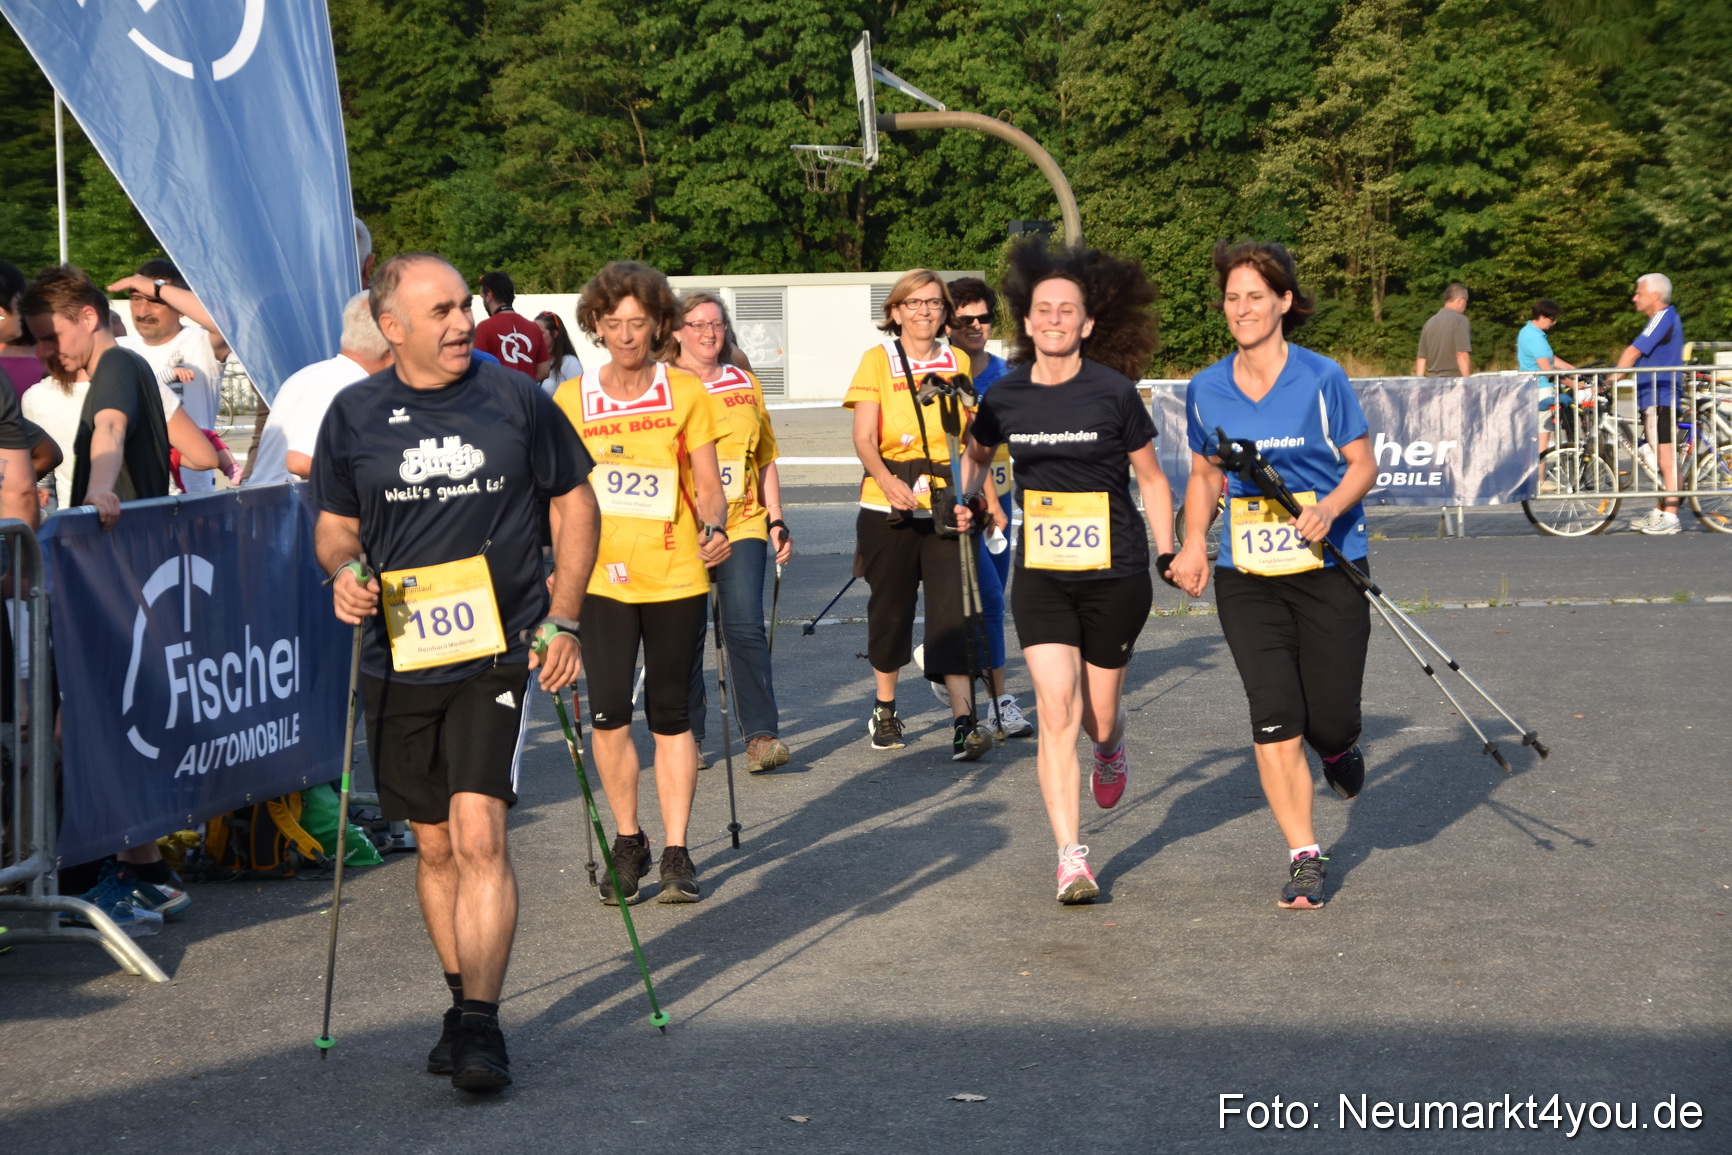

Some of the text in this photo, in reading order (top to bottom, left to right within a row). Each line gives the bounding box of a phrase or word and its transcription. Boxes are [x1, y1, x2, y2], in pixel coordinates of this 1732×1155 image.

[722, 392, 758, 408] BÖGL
[583, 416, 677, 438] MAX BÖGL
[1009, 430, 1098, 445] energiegeladen
[1374, 433, 1458, 466] her
[385, 475, 505, 503] Weil's guad is!
[607, 470, 660, 498] 923
[1376, 472, 1442, 486] OBILE
[1034, 523, 1100, 548] 1326
[1241, 527, 1311, 554] 1329
[408, 601, 475, 640] 180
[173, 711, 300, 779] AUTOMOBILE
